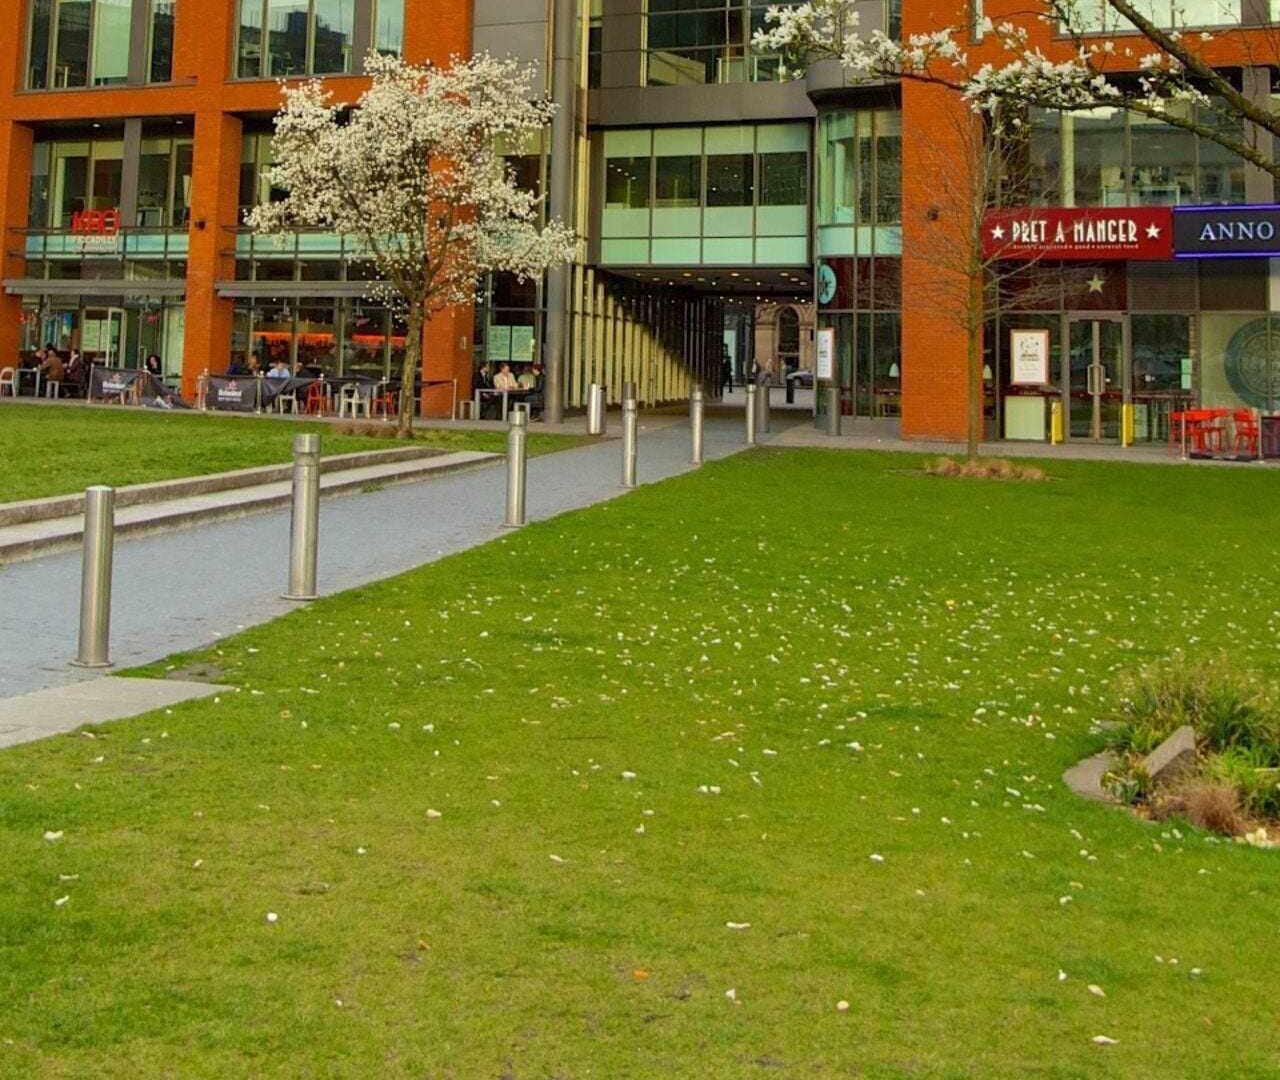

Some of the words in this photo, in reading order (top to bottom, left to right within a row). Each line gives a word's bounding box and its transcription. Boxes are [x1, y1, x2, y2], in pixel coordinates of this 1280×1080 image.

[1012, 220, 1048, 243] PRET
[1055, 220, 1066, 243] A
[1073, 219, 1138, 243] MANGER
[1199, 221, 1275, 240] ANNO
